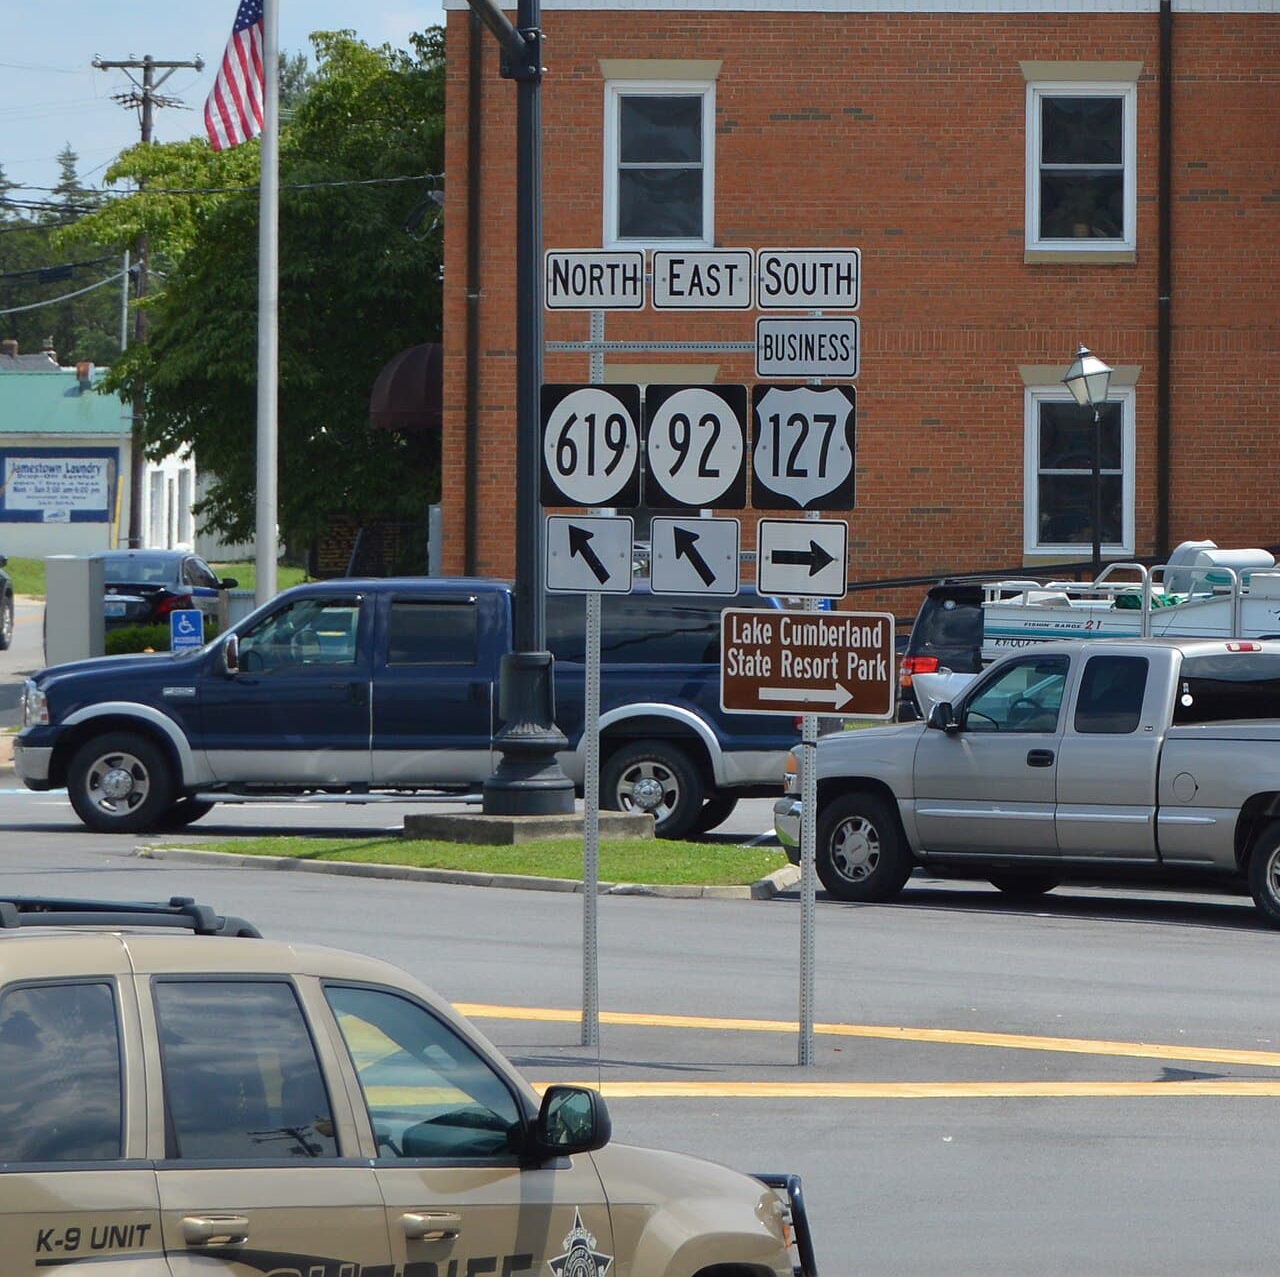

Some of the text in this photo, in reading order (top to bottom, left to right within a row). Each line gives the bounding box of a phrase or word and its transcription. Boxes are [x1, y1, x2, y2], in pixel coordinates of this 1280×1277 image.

[552, 260, 639, 296] NORTH
[668, 259, 739, 297] EAST
[765, 257, 853, 296] SOUTH
[763, 333, 850, 362] BUSINESS
[555, 412, 627, 478] 619
[668, 412, 721, 478] 92
[768, 413, 837, 478] 127
[12, 462, 101, 476] Jamestown Laundry
[731, 616, 882, 649] Lake Cumberland
[1084, 620, 1103, 630] 21
[727, 649, 887, 682] State Resort Park
[36, 1224, 152, 1253] K-9 UNIT
